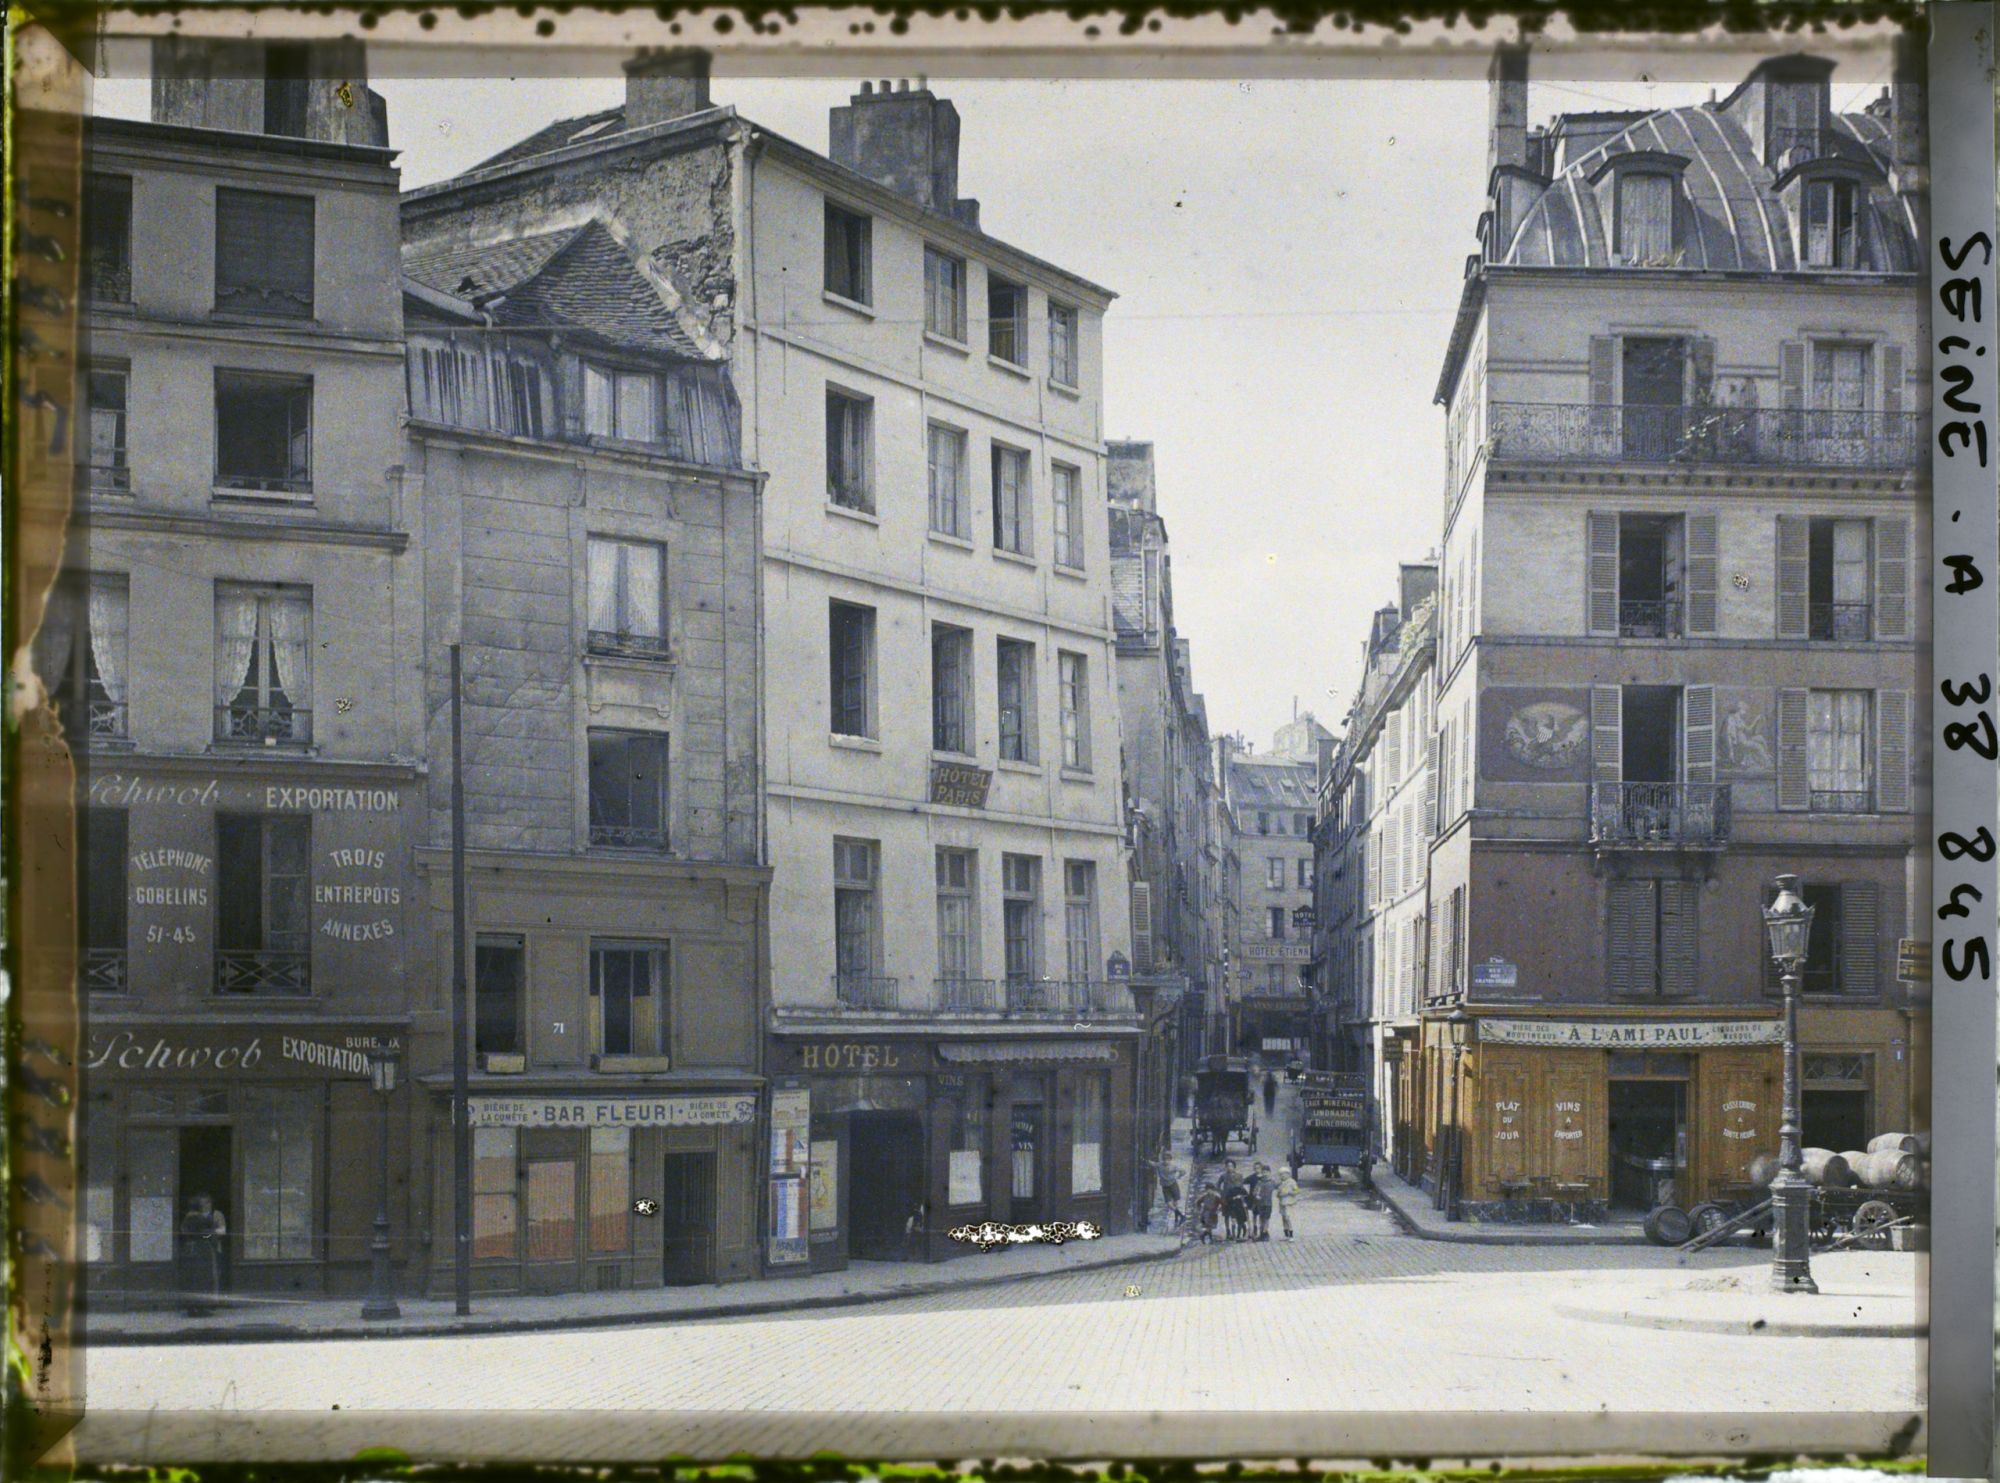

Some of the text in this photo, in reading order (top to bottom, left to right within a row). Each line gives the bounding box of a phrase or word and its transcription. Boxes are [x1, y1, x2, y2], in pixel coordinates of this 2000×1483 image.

[1943, 554, 1982, 596] A
[1941, 673, 1998, 760] 38
[266, 787, 400, 811] EXPORTATION
[936, 785, 981, 805] PARIS
[329, 849, 386, 870] TROIS
[136, 886, 208, 906] GOBELINS
[315, 882, 400, 905] ENTREPÔTS
[1938, 827, 1996, 982] 845
[320, 918, 394, 942] ANNEXES
[553, 1022, 565, 1034] 71
[1654, 1027, 1704, 1041] PAUL
[345, 1036, 400, 1049] BUREX
[87, 1031, 373, 1077] Schwob EXPORTATION
[937, 1073, 965, 1086] VINS
[513, 1103, 525, 1112] DE
[718, 1101, 728, 1109] DE
[1495, 1101, 1521, 1112] PLAT
[1555, 1101, 1581, 1112] VINS
[481, 1113, 492, 1122] LA
[543, 1104, 674, 1122] BAR FLEURI
[688, 1111, 698, 1120] LA
[1494, 1130, 1519, 1140] JOUR
[1554, 1129, 1583, 1140] EMPORTER
